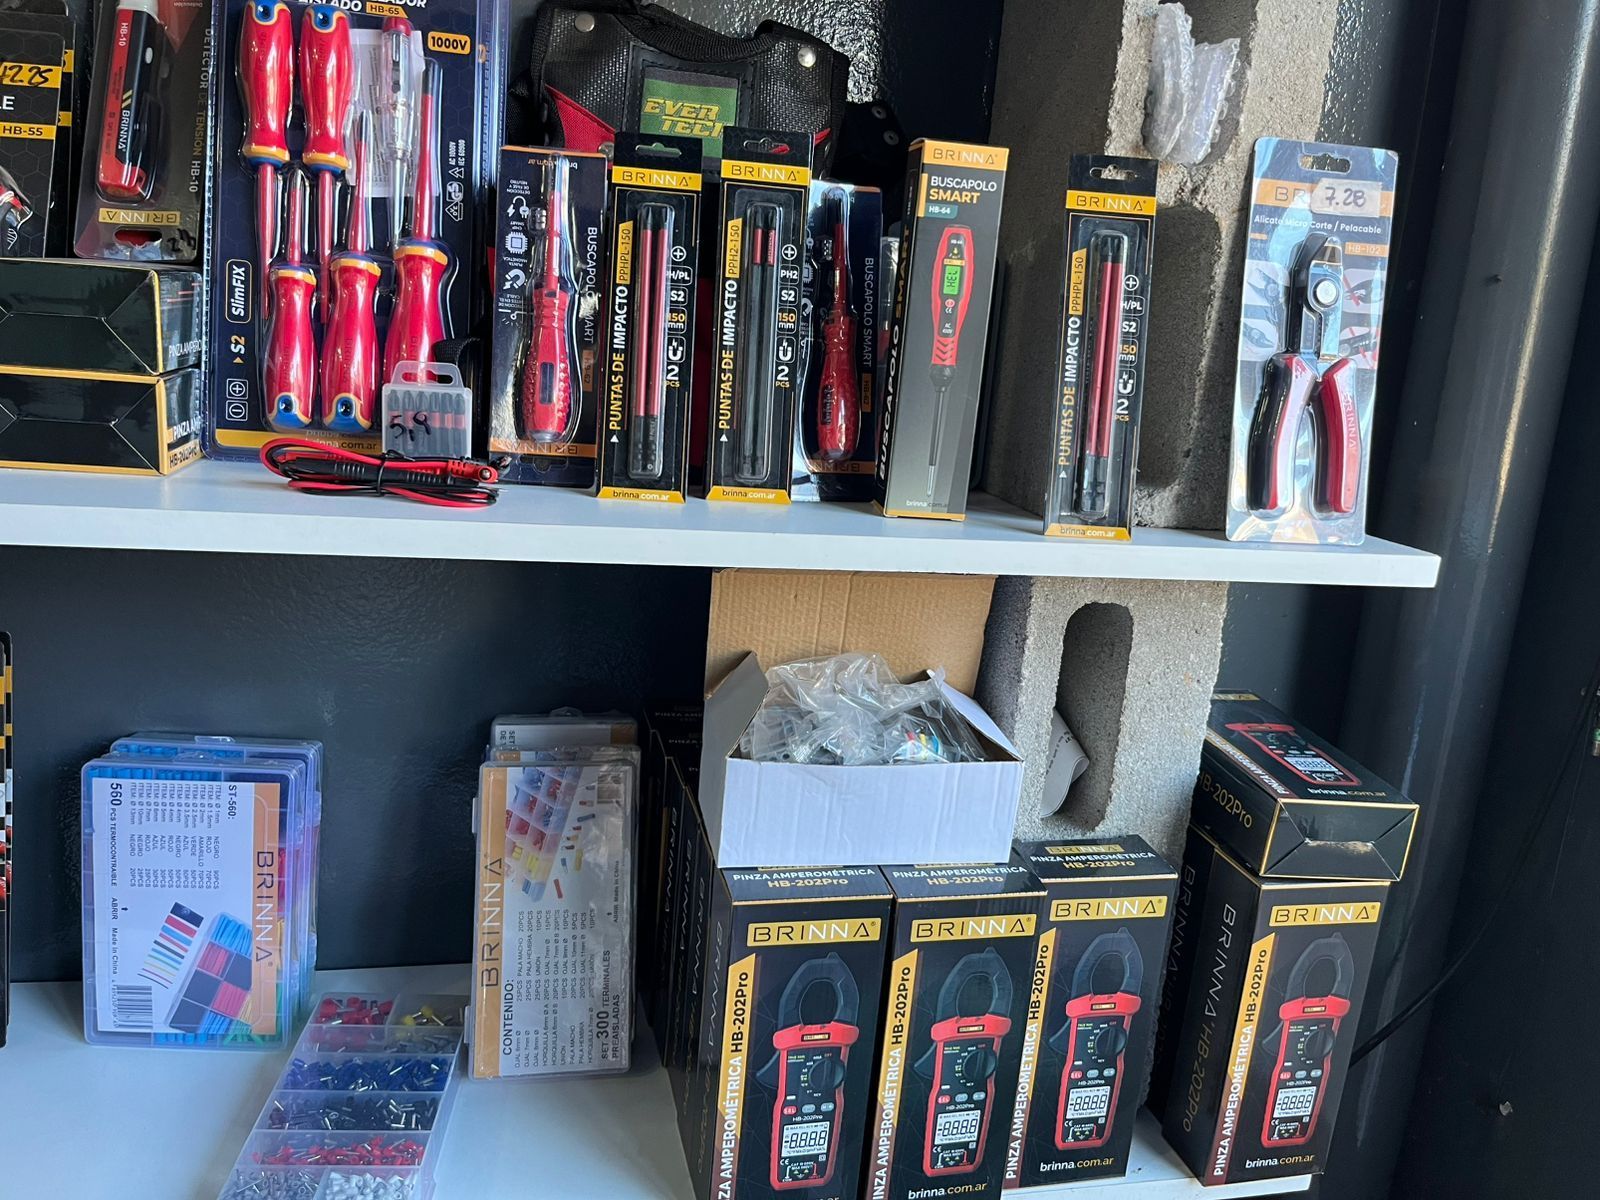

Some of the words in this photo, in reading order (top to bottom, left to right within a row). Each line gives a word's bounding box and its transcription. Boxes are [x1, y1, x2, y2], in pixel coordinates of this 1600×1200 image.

[370, 5, 399, 15] HB-65
[119, 22, 129, 46] HB-10
[431, 36, 468, 51] 1000V
[644, 97, 720, 121] EVER
[3, 125, 43, 136] HB-55
[117, 109, 131, 150] BRINNA
[933, 148, 995, 165] BRINNA
[188, 160, 201, 192] HB-10
[621, 171, 688, 187] BRINNA
[731, 164, 797, 182] BRINNA
[931, 176, 997, 192] BUSCAPOLO
[929, 188, 980, 204] SMART
[1076, 195, 1144, 212] BRINNA
[1325, 186, 1367, 208] 7.28
[106, 210, 178, 223] BRINNA
[928, 204, 951, 214] HB-64
[1310, 220, 1332, 231] Corte
[619, 228, 632, 282] PPHPL-150
[728, 224, 740, 276] PPH2-150
[780, 269, 799, 280] PH2
[1071, 256, 1084, 312] PPHPL-150
[231, 264, 246, 317] SlimFIX
[670, 288, 686, 302] S2
[780, 289, 796, 302] S2
[864, 257, 875, 326] BUSCAPOLO
[612, 286, 629, 350] IMPACTO
[722, 279, 738, 346] IMPACTO
[778, 311, 796, 322] 150
[668, 321, 684, 329] mm
[778, 321, 795, 329] mm
[1122, 322, 1137, 333] S2
[231, 335, 246, 355] S2
[863, 329, 873, 367] SMART
[1064, 316, 1081, 382] IMPACTO
[612, 352, 626, 373] DE
[721, 349, 735, 371] DE
[1118, 353, 1135, 362] mm
[666, 365, 680, 381] 2
[776, 365, 790, 381] 2
[775, 380, 790, 388] PCS
[609, 374, 625, 431] PUNTAS
[719, 373, 734, 429] PUNTAS
[879, 324, 900, 480] BUSCAPOLO
[1063, 385, 1076, 406] DE
[1116, 399, 1130, 414] 2
[1058, 406, 1074, 466] PUNTAS
[612, 489, 670, 501] brinna.com.ar
[721, 488, 776, 500] brinna.com.ar
[1061, 526, 1116, 538] brinna.com.ar
[110, 782, 122, 806] 560
[1307, 787, 1387, 797] brinna.com.ar
[227, 784, 237, 821] ST-560:
[1030, 855, 1063, 863] PINZA
[1063, 860, 1136, 869] HB-202Pro
[733, 872, 771, 881] PINZA
[772, 867, 875, 880] AMPEROMÉTRICA
[893, 870, 930, 879] PINZA
[930, 866, 1028, 877] AMPEROMÉTRICA
[926, 876, 1004, 886] HB-202Pro
[767, 877, 849, 889] HB-202Pro
[111, 897, 119, 920] ABRIR
[256, 851, 274, 962] BRINNA
[1055, 900, 1157, 918] BRINNA
[1274, 905, 1371, 923] BRINNA
[481, 857, 502, 988] BRINNA
[753, 921, 871, 942] BRINNA
[916, 918, 1026, 938] BRINNA
[1205, 903, 1237, 1017] BRINNA
[601, 950, 611, 1009] TERMINALES
[1243, 949, 1268, 1023] HB-202Pro
[503, 979, 515, 1056] CONTENIDO:
[596, 1010, 610, 1040] 300
[611, 994, 620, 1060] PREAISLADAS
[601, 1043, 609, 1060] SET
[1006, 1140, 1020, 1179] PINZA
[1029, 944, 1049, 1020] HB-202Pro
[877, 1047, 902, 1162] AMPEROMÉTRICA
[891, 966, 911, 1045] HB-202Pro
[719, 1056, 742, 1182] AMPEROMÉTRICA
[731, 971, 749, 1053] HB-202Pro
[1182, 1026, 1215, 1134] HB-202Pro
[1221, 1025, 1254, 1136] AMPEROMÉTRICA
[1039, 1157, 1115, 1173] brinna.com.ar
[1213, 1137, 1231, 1176] PINZA
[1245, 1153, 1315, 1169] brinna.com.ar
[908, 1182, 988, 1200] brinna.com.ar
